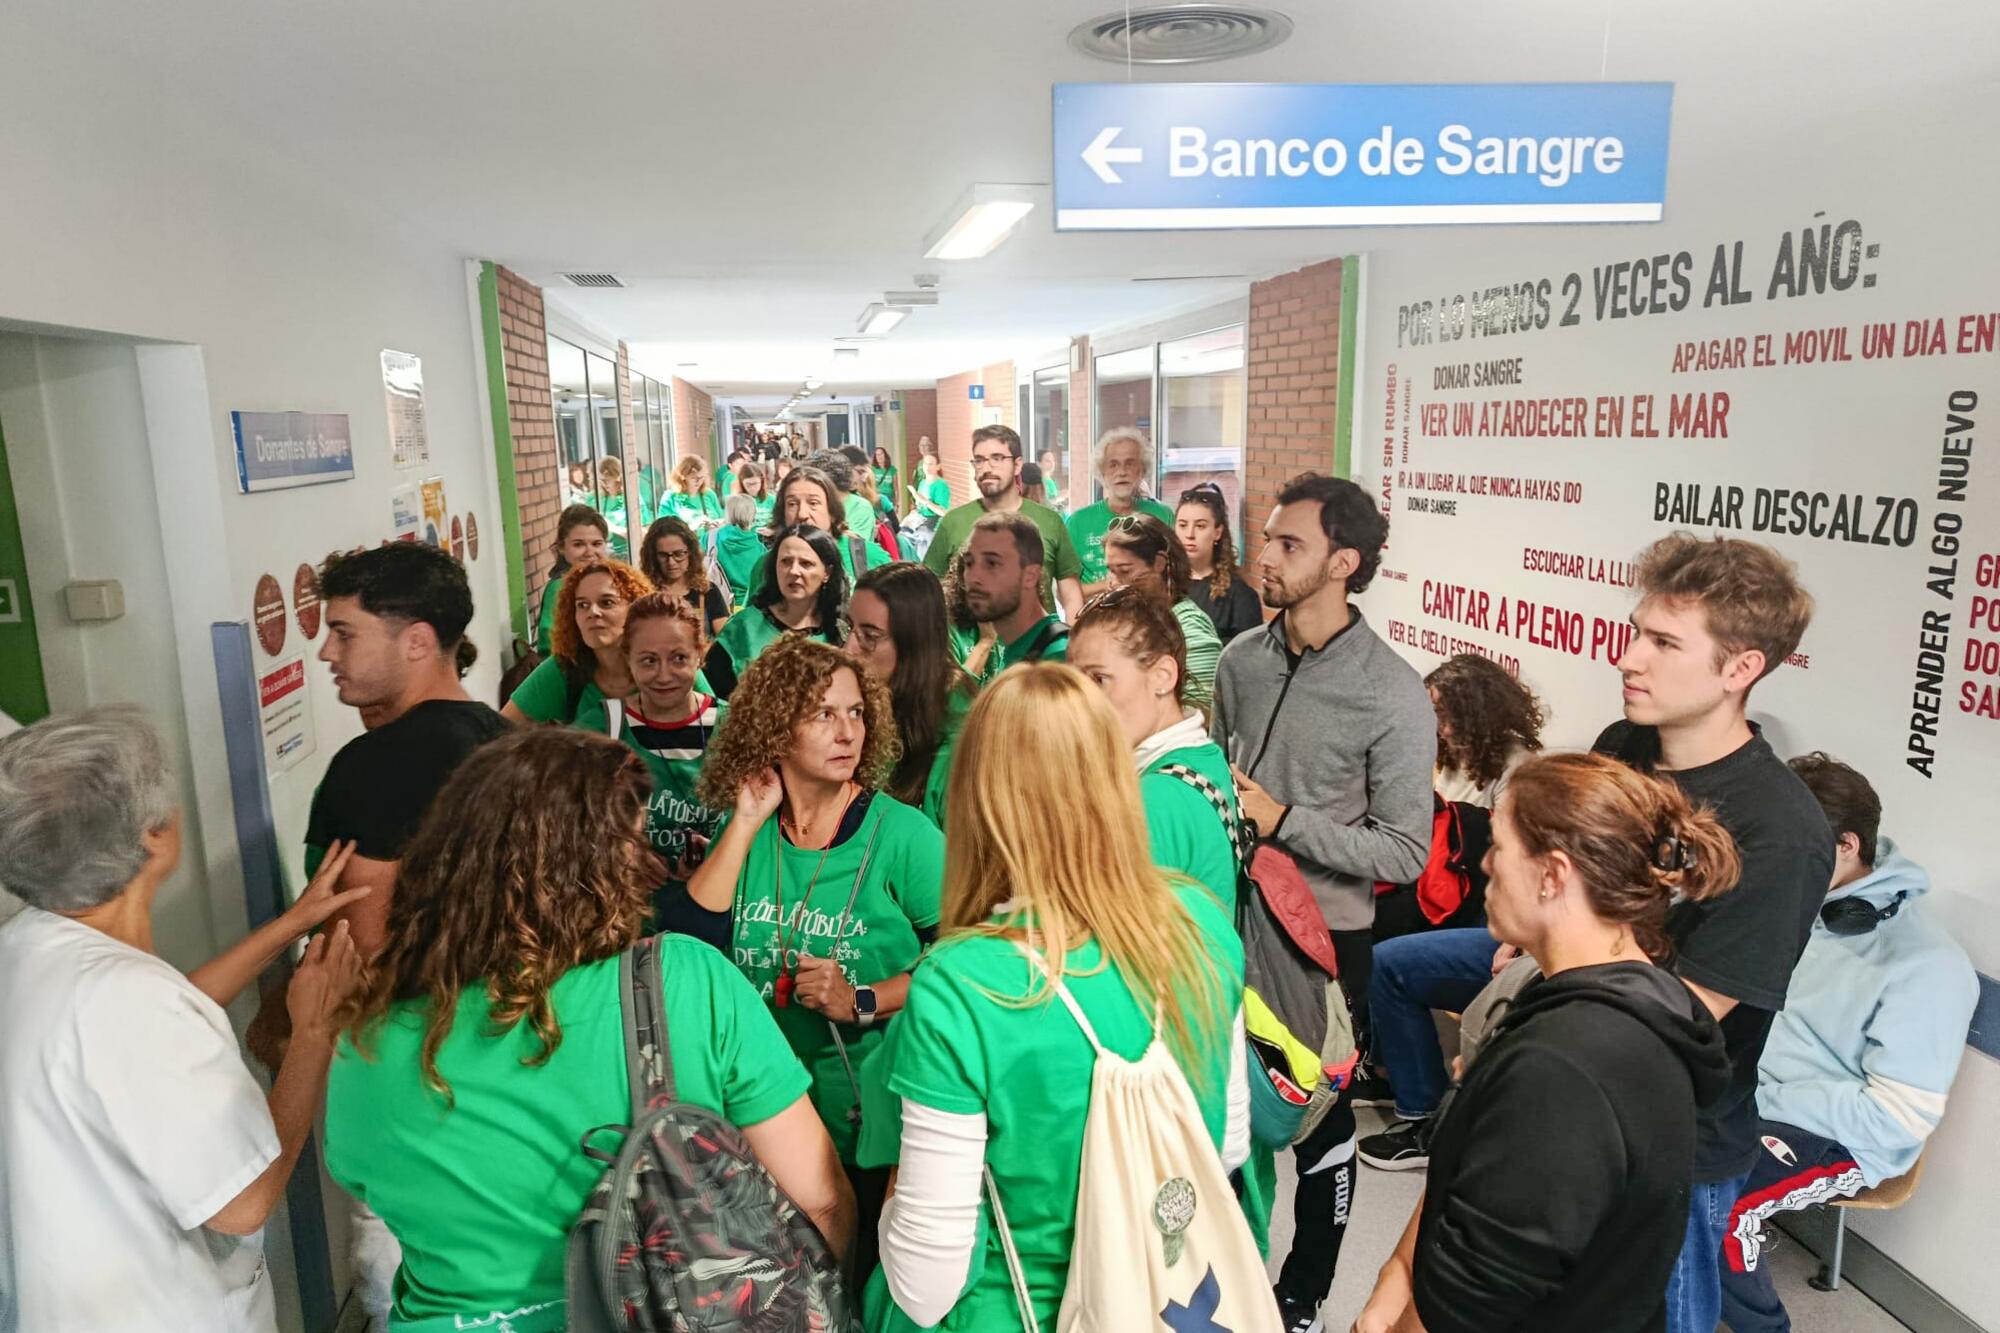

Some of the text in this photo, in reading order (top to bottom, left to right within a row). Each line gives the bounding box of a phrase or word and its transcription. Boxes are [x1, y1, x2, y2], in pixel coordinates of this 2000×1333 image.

[1168, 124, 1624, 187] Banco de Sangre
[1398, 211, 1880, 349] POR LO MENOS 2 VECES AL AÑO:
[1672, 337, 1746, 373] APAGAR
[1753, 334, 1776, 367] EL
[1784, 327, 1852, 364] MOVIL
[1861, 323, 1896, 360] UN
[1903, 318, 1947, 357] DIA
[1434, 357, 1523, 390] DONAR SANGRE
[1385, 364, 1398, 430] RUMBO
[1421, 392, 1730, 438] VER UN ATARDECER EN EL MAR
[256, 434, 305, 462] Donantes
[1383, 437, 1394, 468] SIN
[1407, 472, 1413, 488] A
[1415, 472, 1425, 489] UN
[1427, 473, 1453, 492] LUGAR
[1456, 475, 1467, 494] AL
[1470, 476, 1487, 495] QUE
[1490, 477, 1521, 499] NUNCA
[1524, 479, 1560, 501] HAYAS
[1564, 482, 1582, 504] IDO
[1408, 497, 1457, 516] DONAR SANGRE
[1654, 482, 1918, 547] BAILAR DESCALZO
[1523, 548, 1584, 579] ESCUCHAR
[1588, 557, 1605, 583] LA
[1906, 390, 1978, 779] APRENDER ALGO NUEVO
[1388, 619, 1404, 643] VER
[1408, 625, 1418, 647] EL
[1421, 629, 1447, 656] CIELO
[1422, 580, 1489, 631] CANTAR
[1496, 597, 1508, 636] A
[1515, 600, 1584, 655] PLENO
